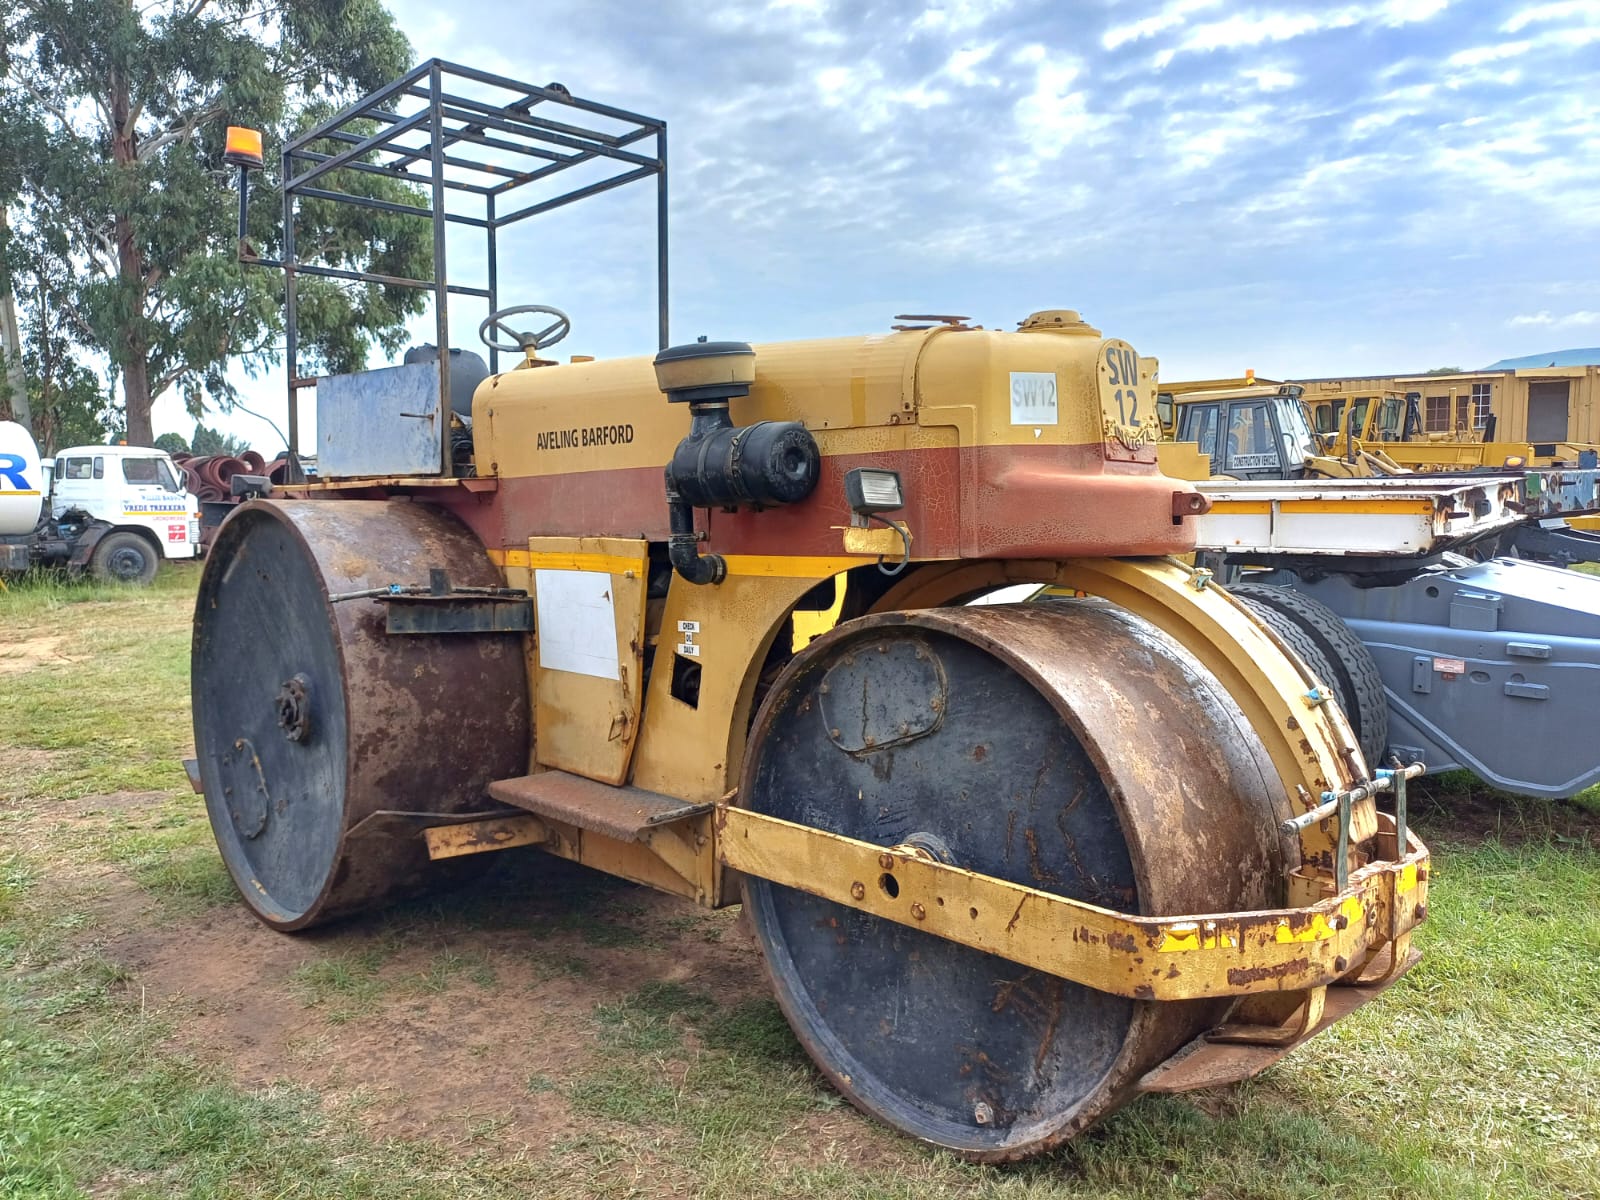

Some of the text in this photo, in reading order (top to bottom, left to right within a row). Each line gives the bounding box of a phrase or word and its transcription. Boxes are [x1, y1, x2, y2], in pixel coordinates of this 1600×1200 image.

[1106, 347, 1138, 386] SW
[1013, 379, 1056, 408] SW12
[1114, 389, 1140, 427] 12
[537, 424, 634, 450] AVELING BARFORD
